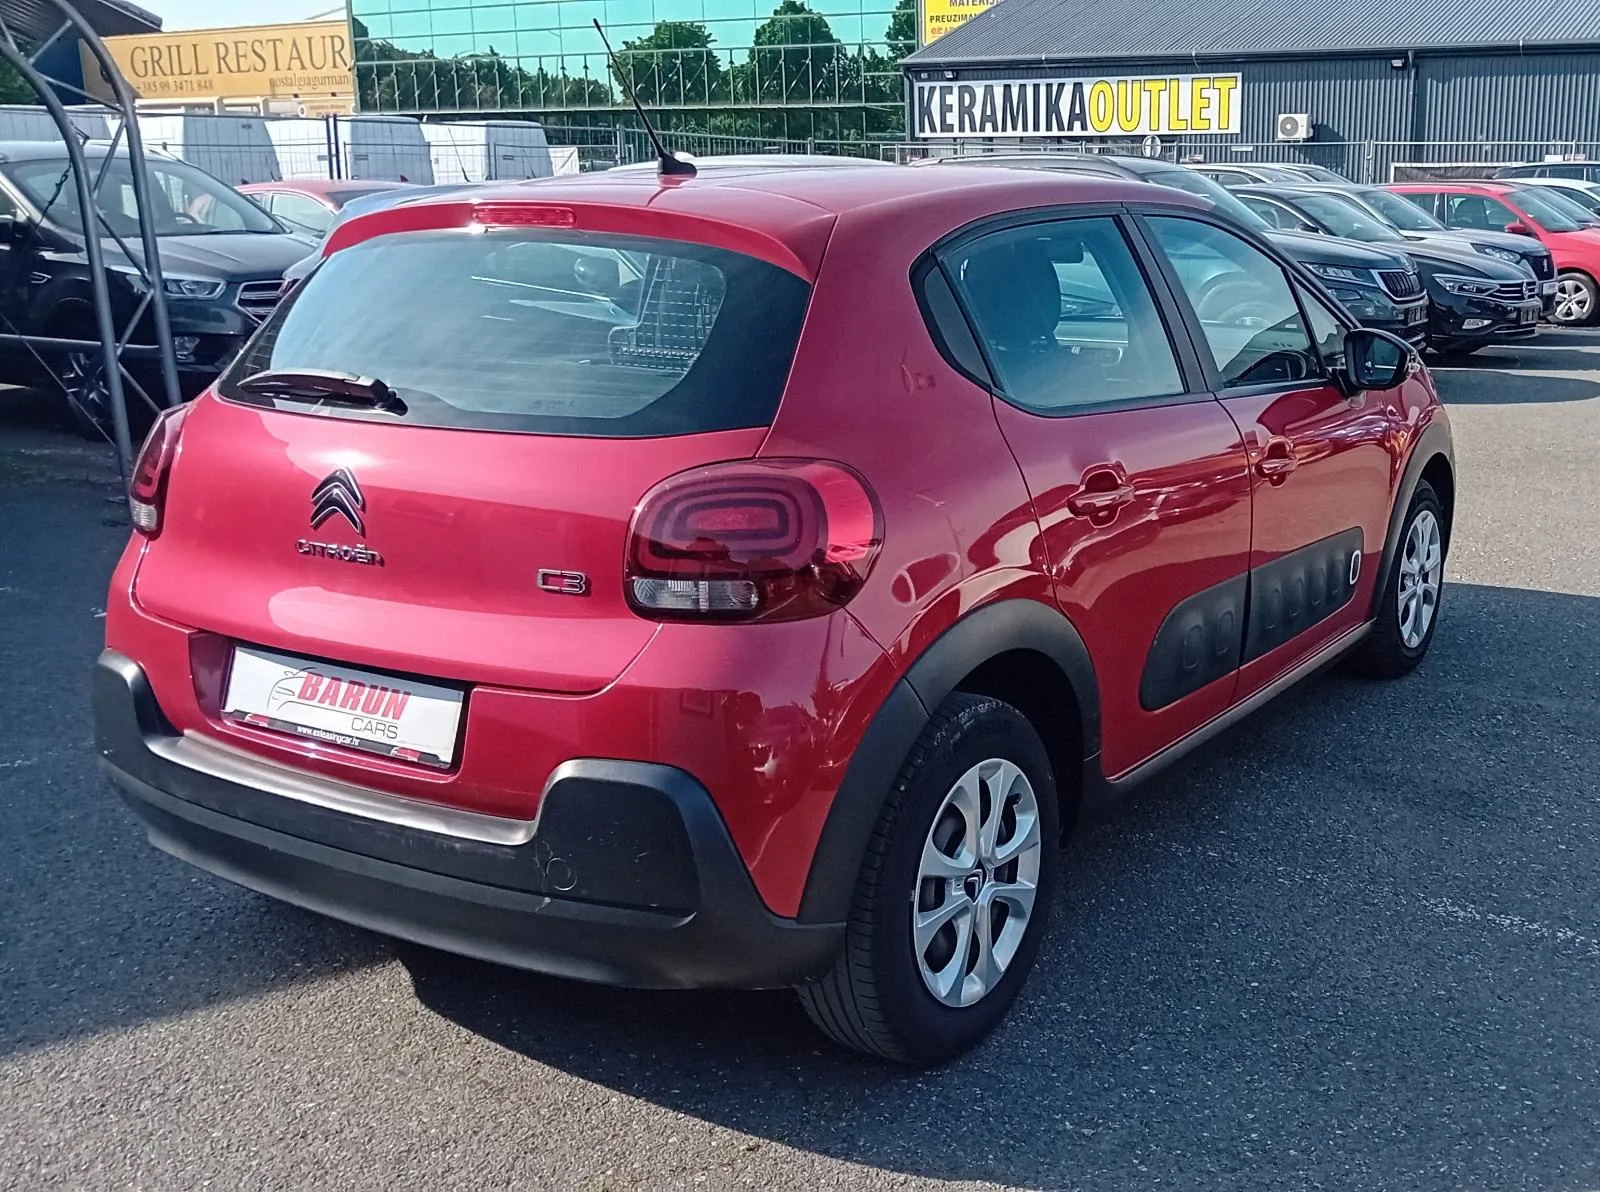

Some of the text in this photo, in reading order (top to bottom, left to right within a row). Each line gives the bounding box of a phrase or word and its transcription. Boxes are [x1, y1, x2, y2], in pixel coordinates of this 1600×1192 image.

[130, 34, 348, 78] GRILL RESTAUR
[536, 568, 590, 595] C3
[297, 671, 411, 720] BARUN
[350, 716, 399, 740] CARS
